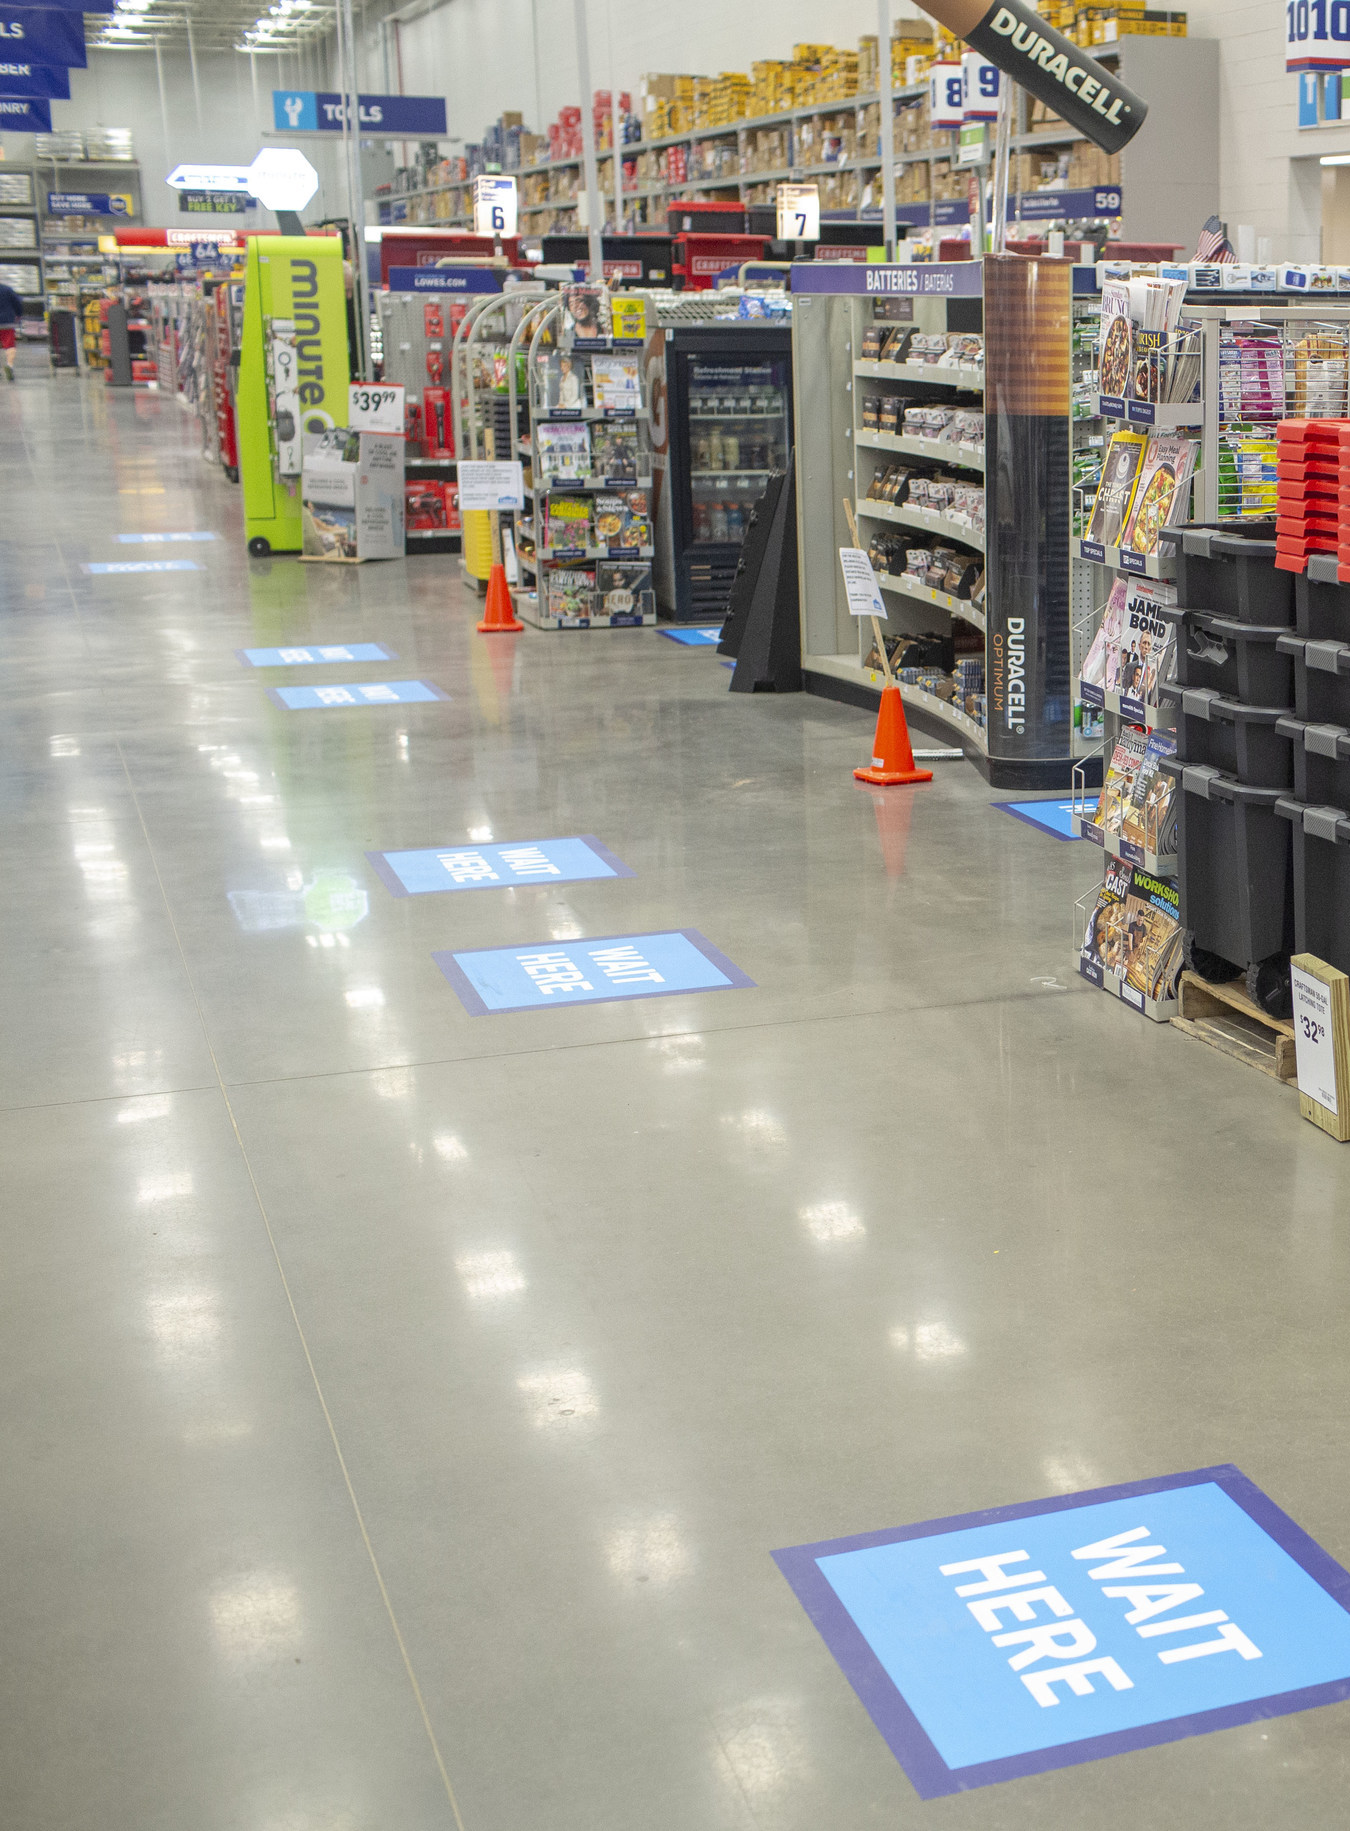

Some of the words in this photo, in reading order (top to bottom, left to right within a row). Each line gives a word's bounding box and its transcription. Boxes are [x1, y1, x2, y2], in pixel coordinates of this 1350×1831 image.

[989, 8, 1122, 125] DURACELL
[946, 78, 961, 107] 8
[979, 66, 999, 97] 9
[1095, 193, 1120, 209] 59
[492, 206, 504, 230] 6
[795, 214, 806, 236] 7
[196, 243, 217, 258] 64
[866, 270, 918, 291] BATTERIES
[924, 270, 954, 292] BATERÍAS
[290, 259, 325, 406] minute
[1156, 454, 1176, 465] Planning
[1158, 444, 1168, 454] Easy
[1168, 445, 1180, 455] Meal
[1130, 612, 1166, 639] BOND
[992, 634, 1004, 711] OPTIMUM
[1007, 617, 1025, 730] DURACELL
[436, 852, 500, 883] HERE
[498, 847, 560, 876] WAIT
[1106, 874, 1128, 898] CAST
[1150, 894, 1180, 920] solutions
[516, 952, 594, 995] HERE
[588, 945, 666, 984] WAIT
[1070, 1525, 1264, 1665] WAIT
[938, 1549, 1135, 1708] HERE
